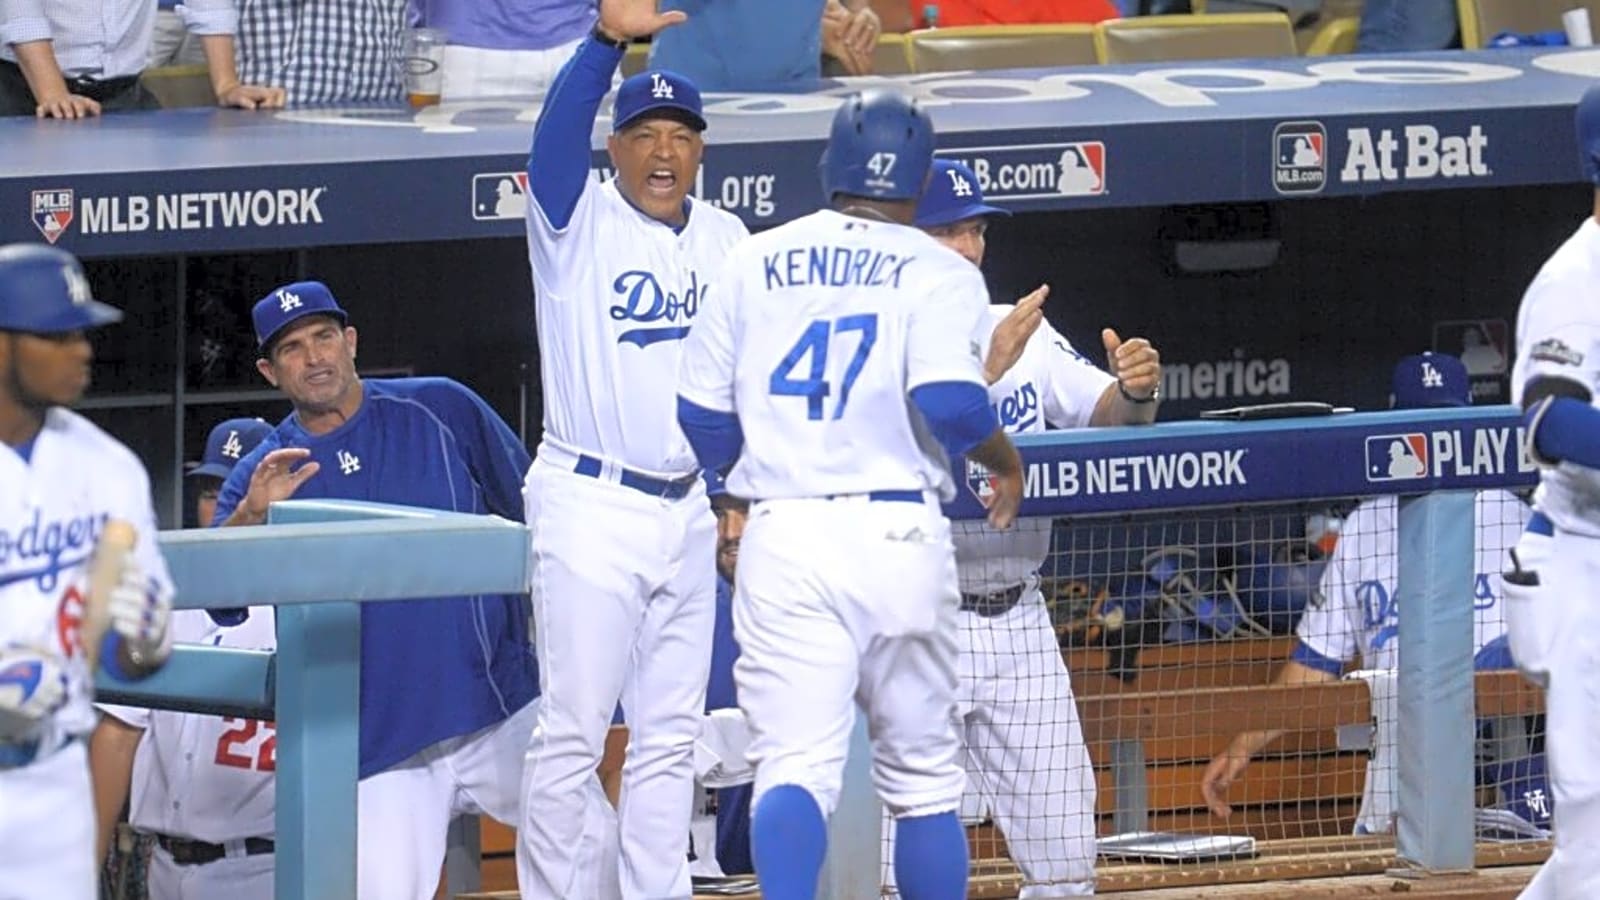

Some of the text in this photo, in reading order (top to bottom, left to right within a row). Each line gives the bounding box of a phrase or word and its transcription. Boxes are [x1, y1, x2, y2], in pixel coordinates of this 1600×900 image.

[651, 73, 674, 99] LA
[867, 152, 897, 176] 47
[1341, 125, 1488, 182] At Bat
[947, 169, 973, 196] LA
[1276, 170, 1323, 183] MLB.com
[35, 193, 70, 208] MLB
[81, 188, 323, 233] MLB NETWORK
[763, 246, 917, 291] KENDRICK
[276, 290, 303, 312] LA
[769, 313, 878, 421] 47
[1159, 348, 1291, 399] merica
[1421, 362, 1444, 388] LA
[222, 430, 243, 459] LA
[1431, 427, 1510, 478] PLAY
[337, 449, 362, 475] LA
[1023, 449, 1247, 498] MLB NETWORK
